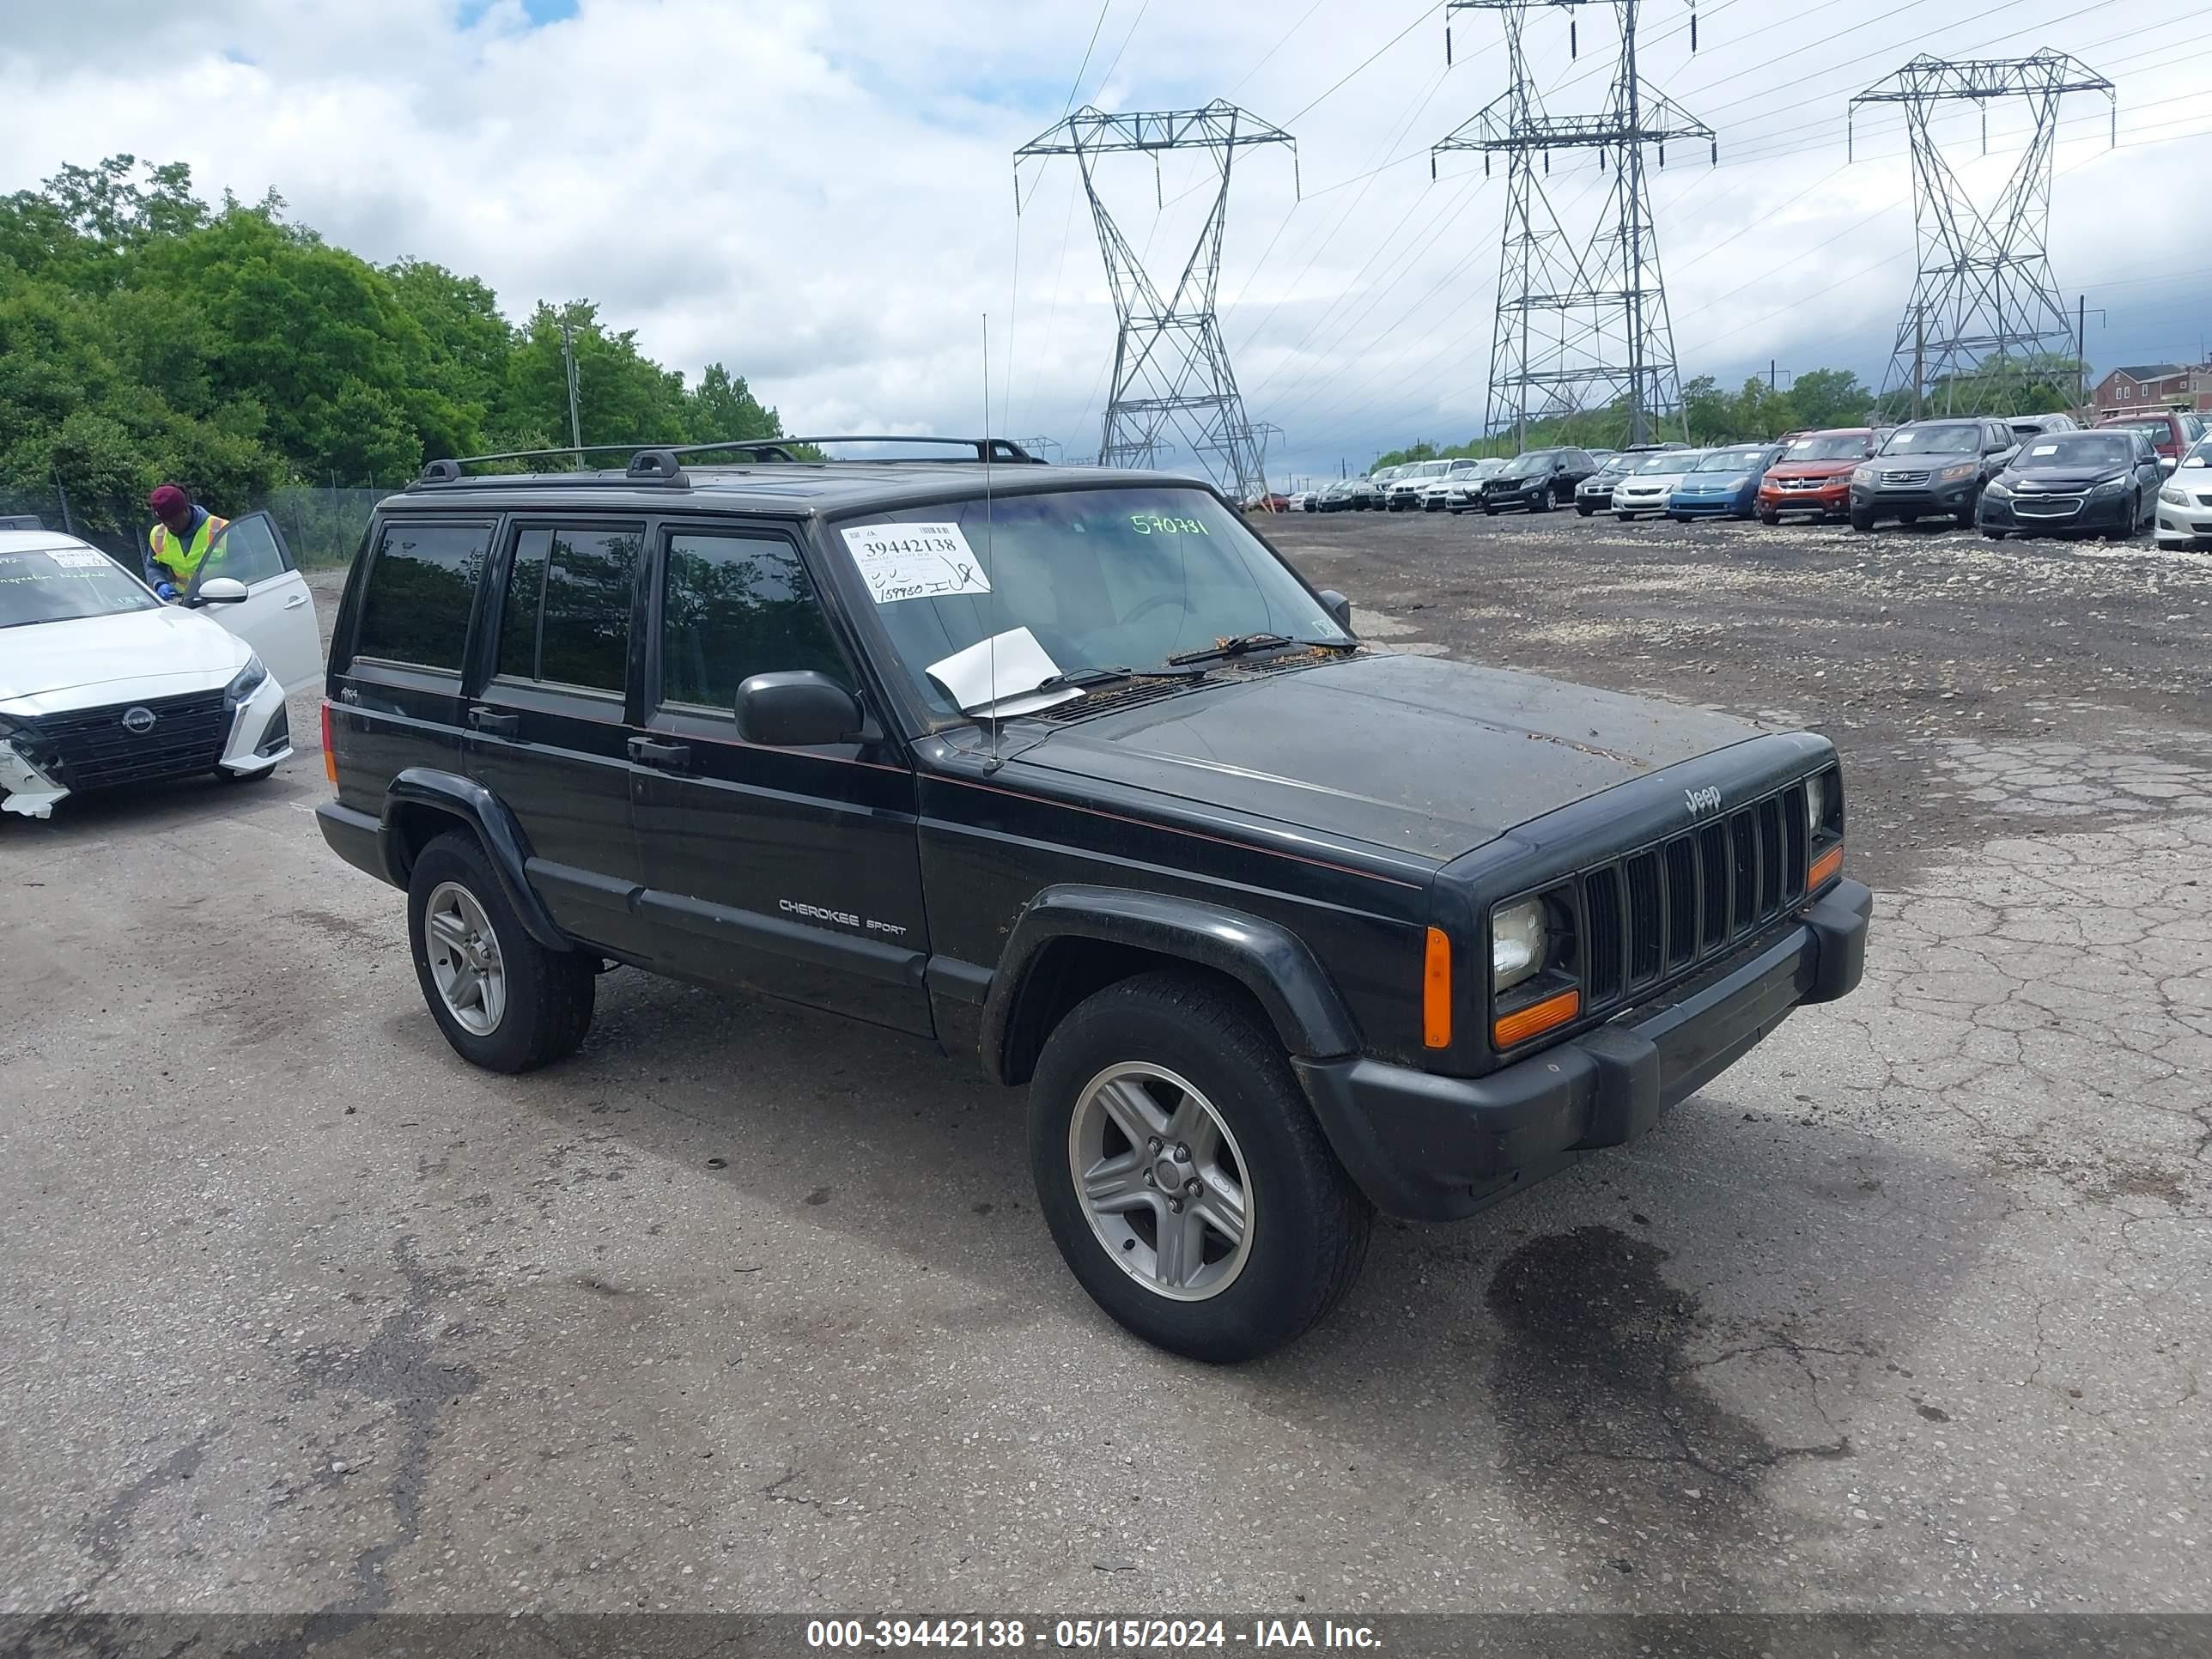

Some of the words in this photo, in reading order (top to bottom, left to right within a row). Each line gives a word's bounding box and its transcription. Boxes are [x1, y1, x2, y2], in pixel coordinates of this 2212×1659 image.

[1130, 515, 1209, 535] 570731
[863, 538, 957, 557] 39442138
[1684, 786, 1722, 812] Jeep
[779, 899, 860, 927] CHEROKEE
[866, 920, 907, 935] SPORT
